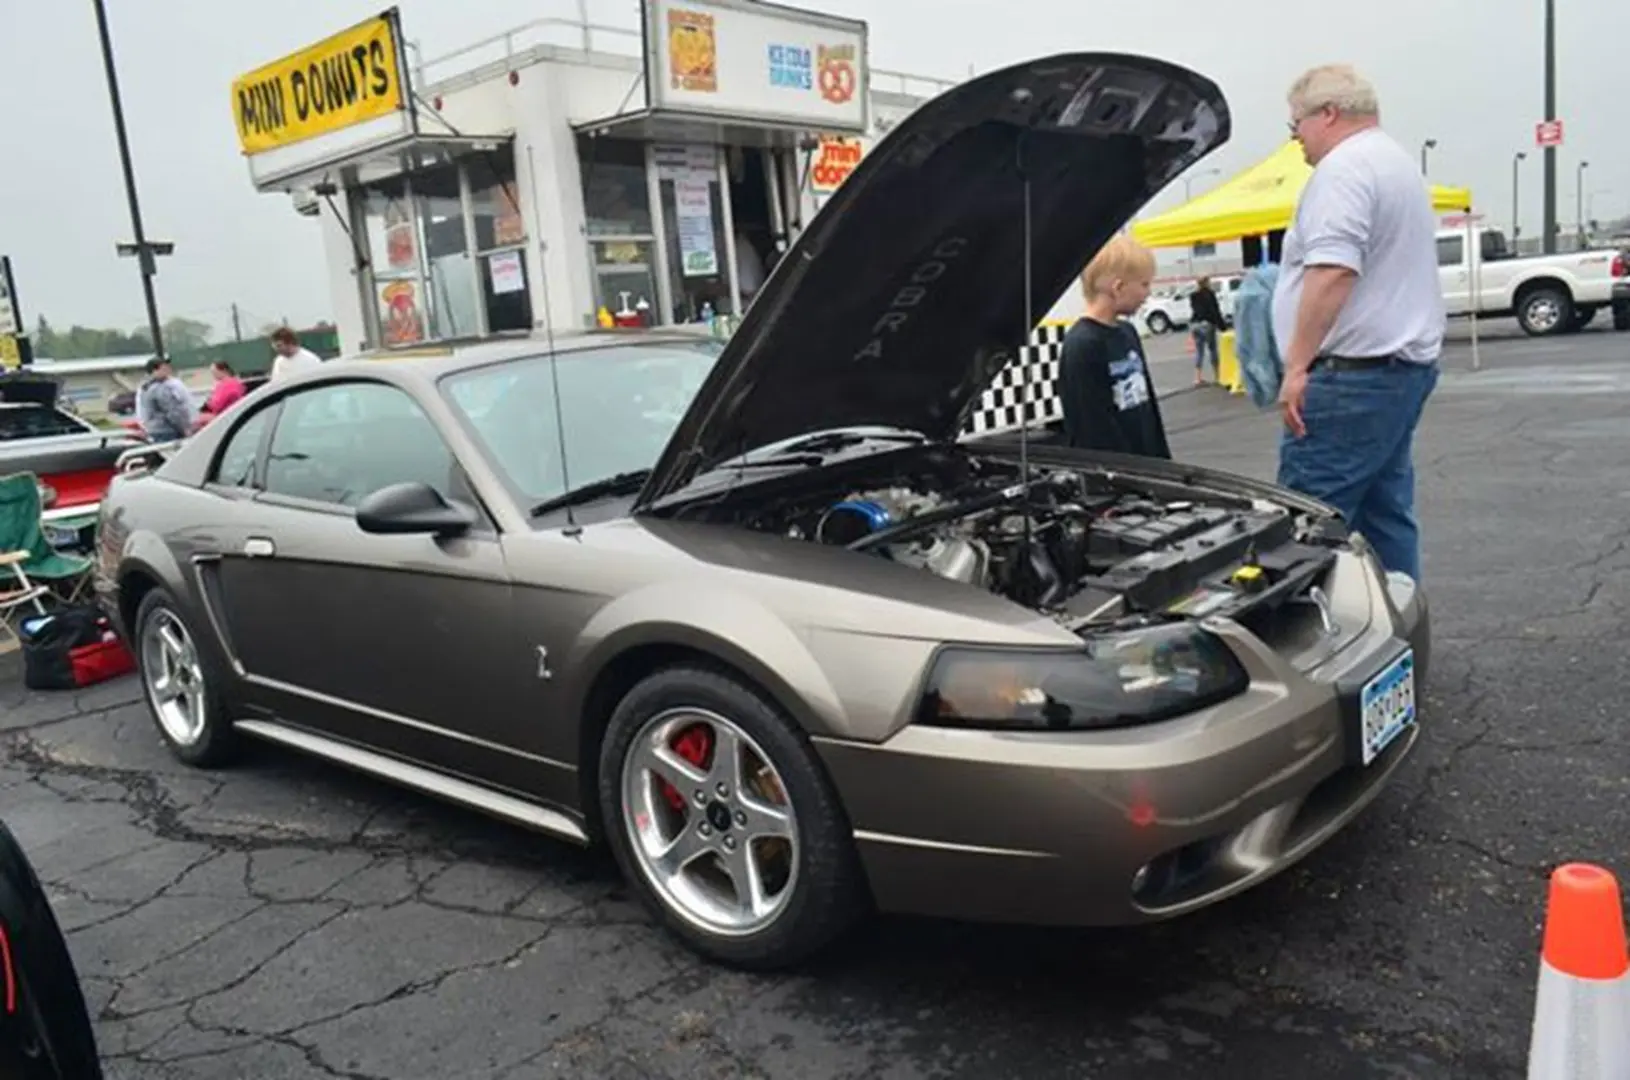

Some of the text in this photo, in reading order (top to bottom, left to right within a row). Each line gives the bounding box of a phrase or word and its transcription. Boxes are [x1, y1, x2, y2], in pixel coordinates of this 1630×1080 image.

[239, 38, 389, 135] MINI DONUTS
[823, 142, 860, 163] mini
[854, 237, 968, 361] COBRA
